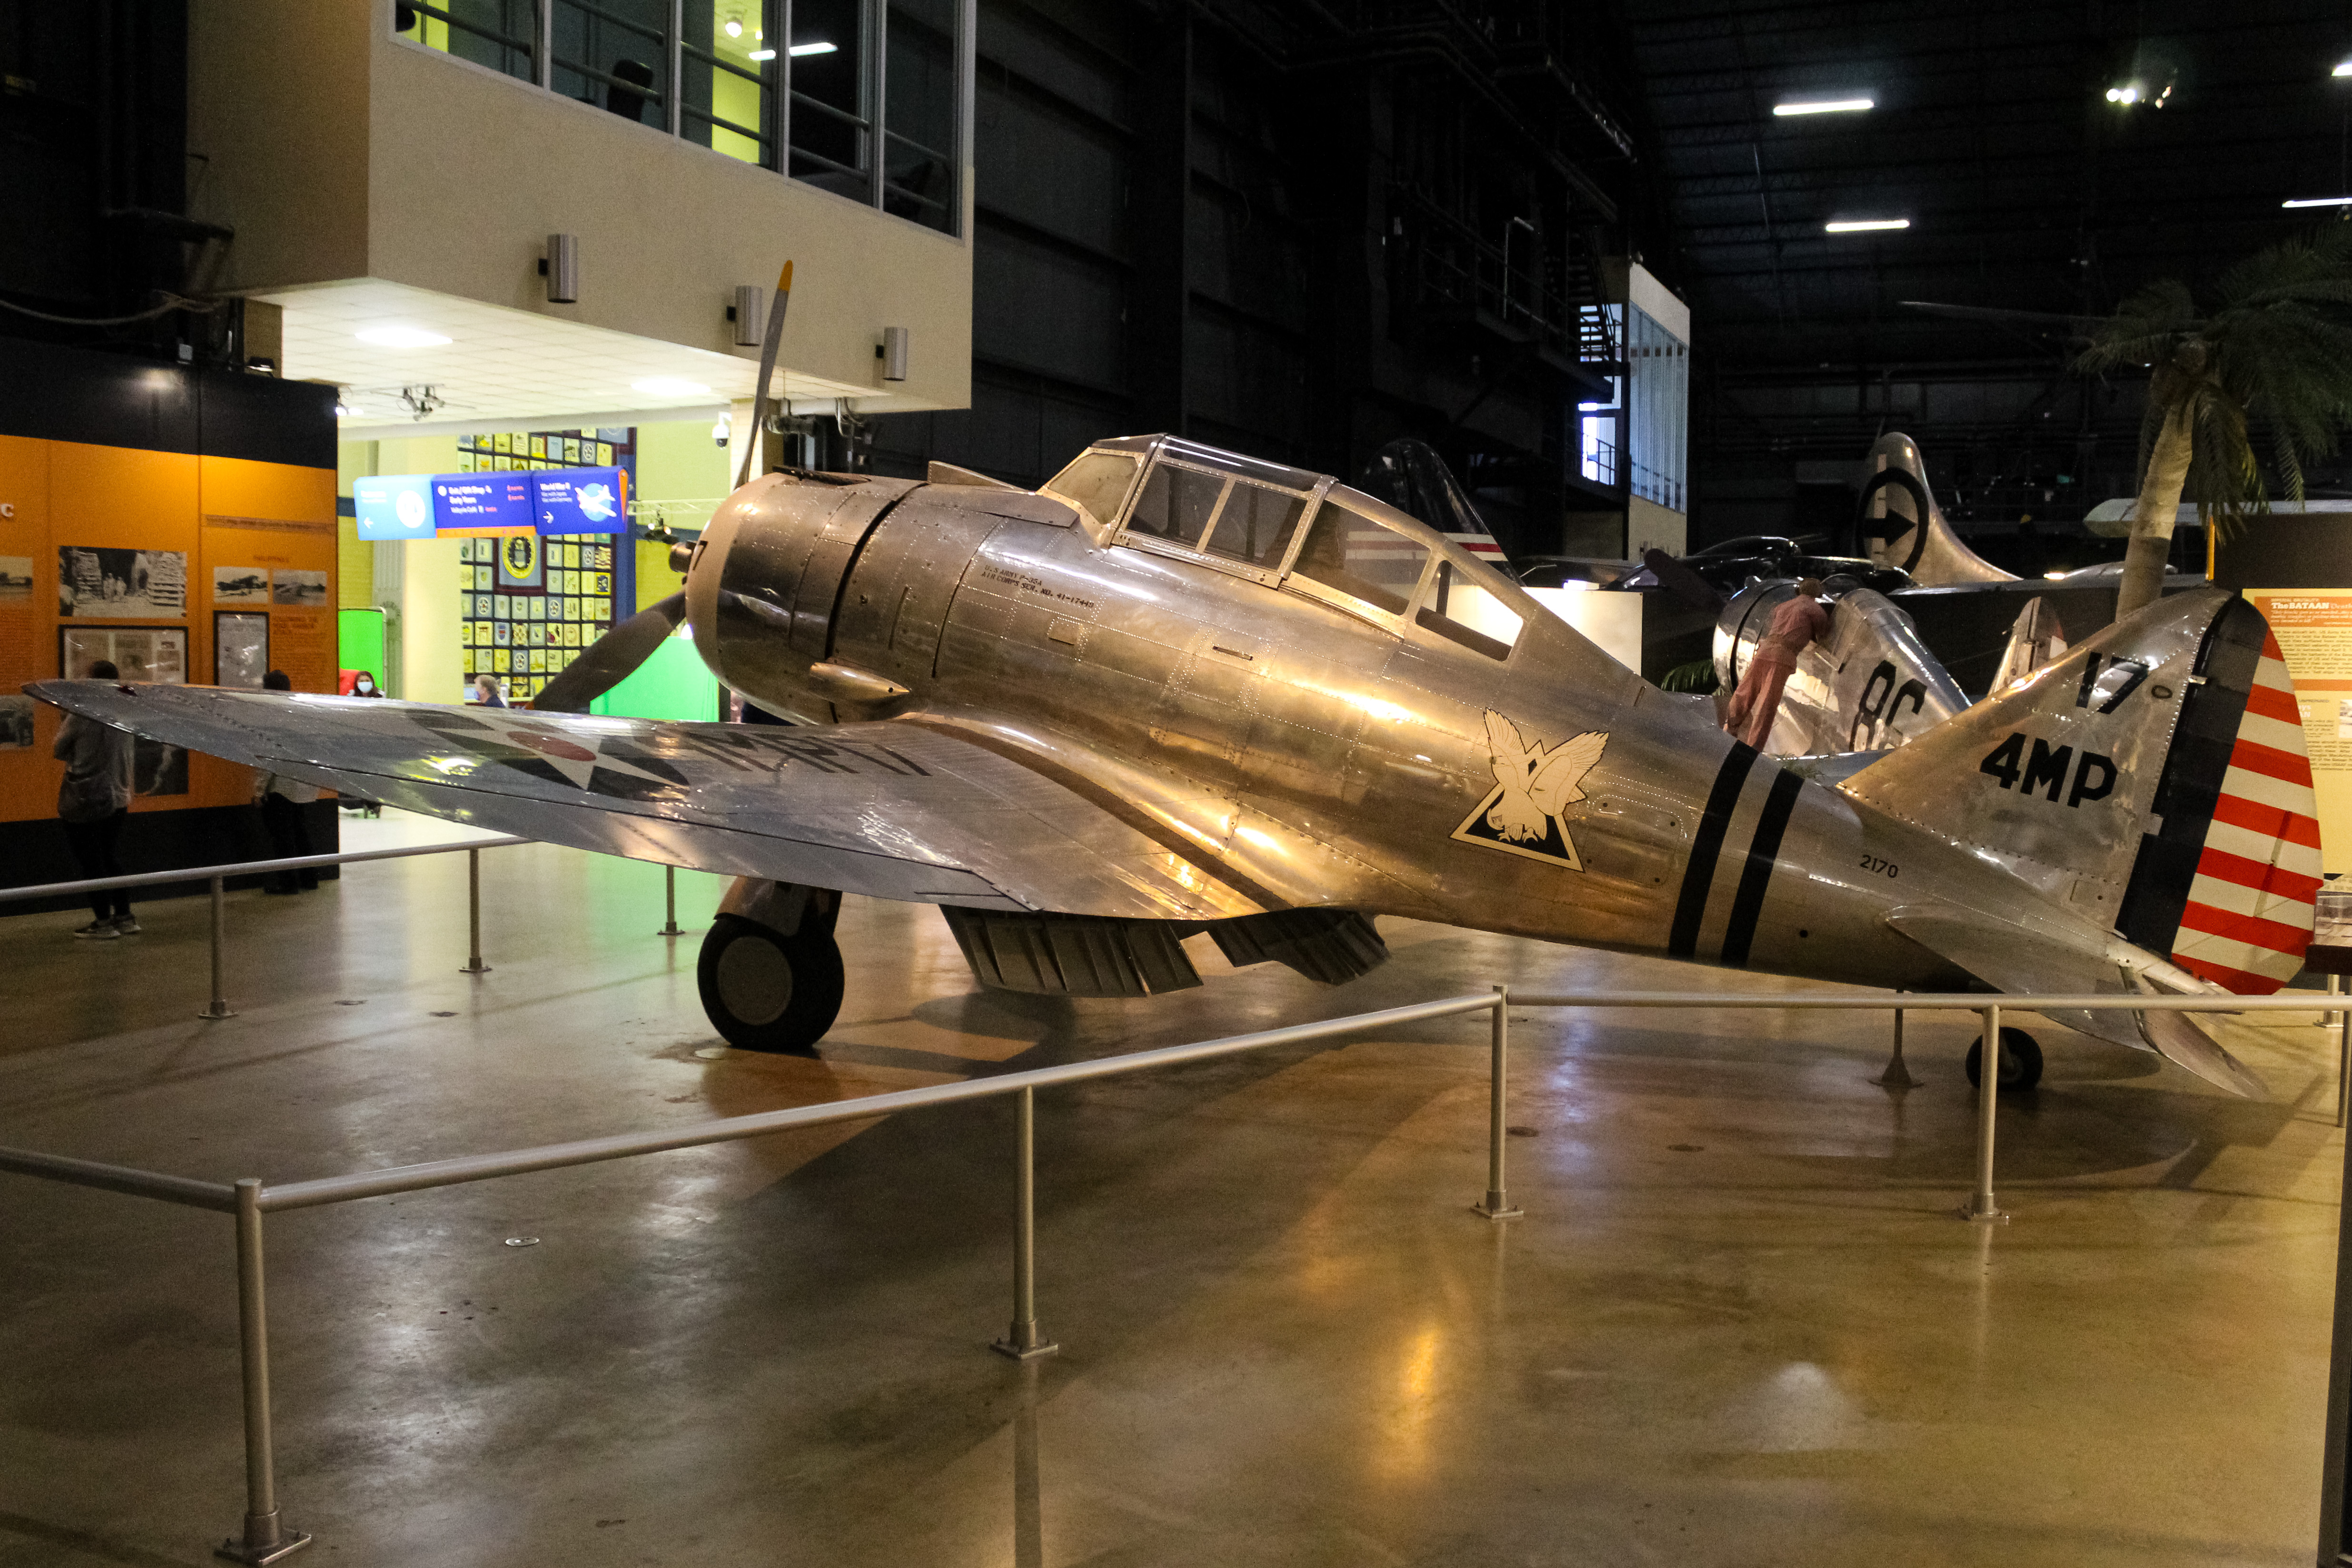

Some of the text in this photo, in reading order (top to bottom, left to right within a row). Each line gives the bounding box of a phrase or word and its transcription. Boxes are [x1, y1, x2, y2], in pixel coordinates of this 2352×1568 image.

[693, 541, 708, 570] 7
[997, 575, 1019, 586] CORPS
[2075, 651, 2149, 715] 17
[1979, 732, 2118, 808] 4MP
[1860, 854, 1898, 878] 2170
